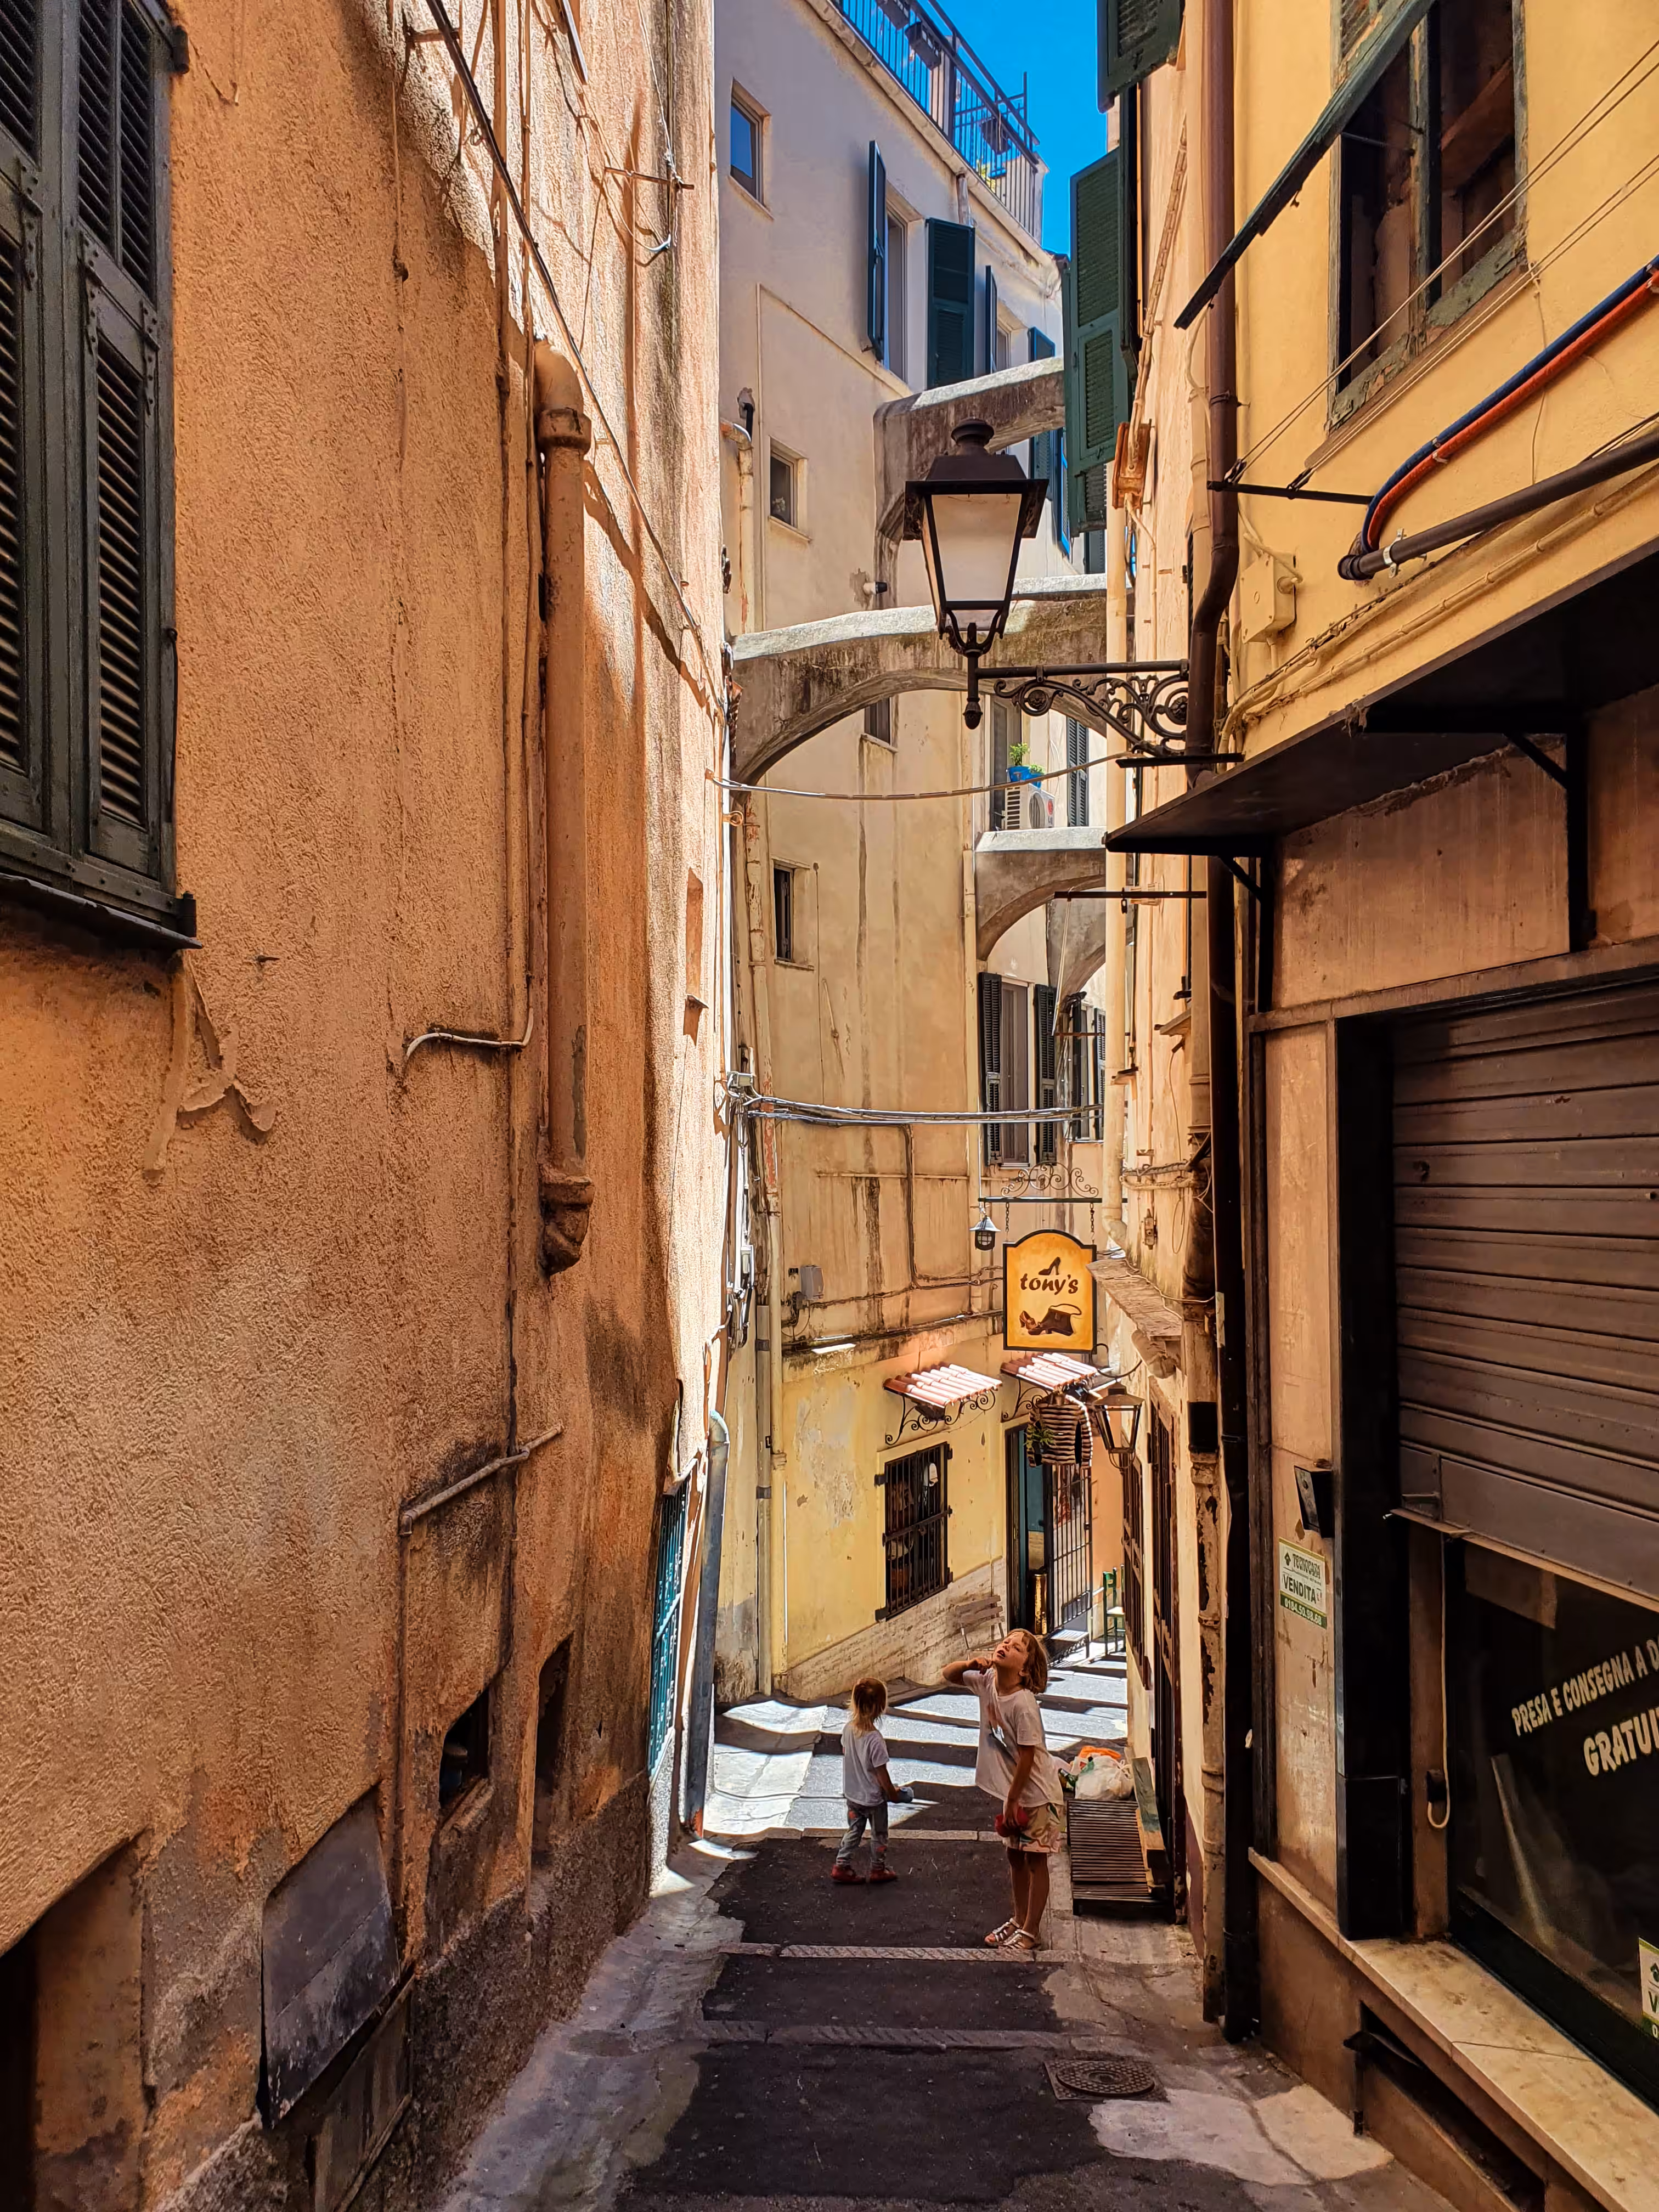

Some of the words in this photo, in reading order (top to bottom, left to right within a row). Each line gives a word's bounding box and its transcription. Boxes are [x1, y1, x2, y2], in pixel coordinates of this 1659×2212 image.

[1020, 1273, 1079, 1295] tony's
[1283, 1573, 1317, 1604] VENDITA
[1511, 1693, 1553, 1736] PRESA
[1550, 1687, 1563, 1717] E
[1562, 1651, 1635, 1712] CONSEGNA
[1635, 1645, 1649, 1678] A
[1646, 1634, 1659, 1672] D
